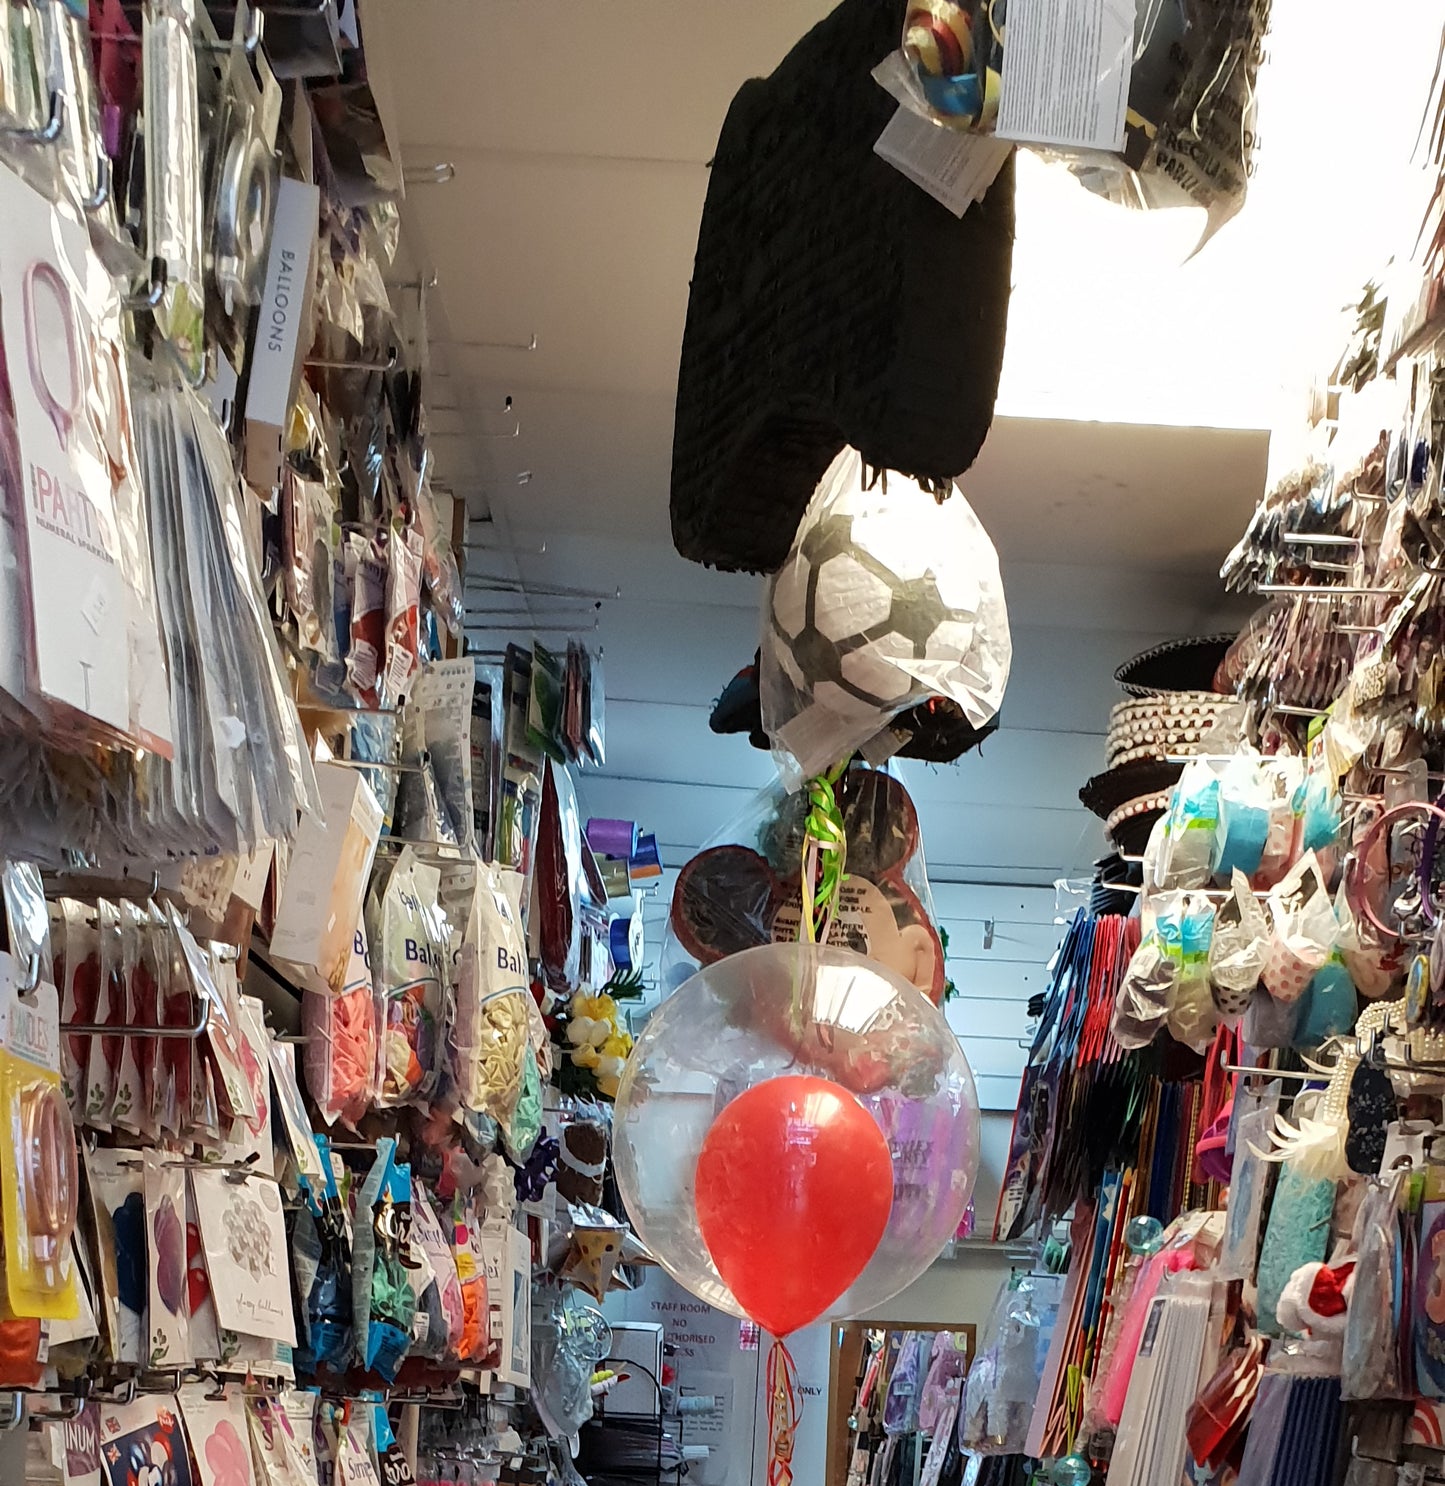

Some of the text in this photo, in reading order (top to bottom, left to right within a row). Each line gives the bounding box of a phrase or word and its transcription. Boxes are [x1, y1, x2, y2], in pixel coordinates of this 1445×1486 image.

[267, 248, 296, 353] BALLOONS
[650, 1301, 711, 1314] STAFF ROOM
[672, 1318, 687, 1328] NO
[797, 1387, 822, 1396] ONLY
